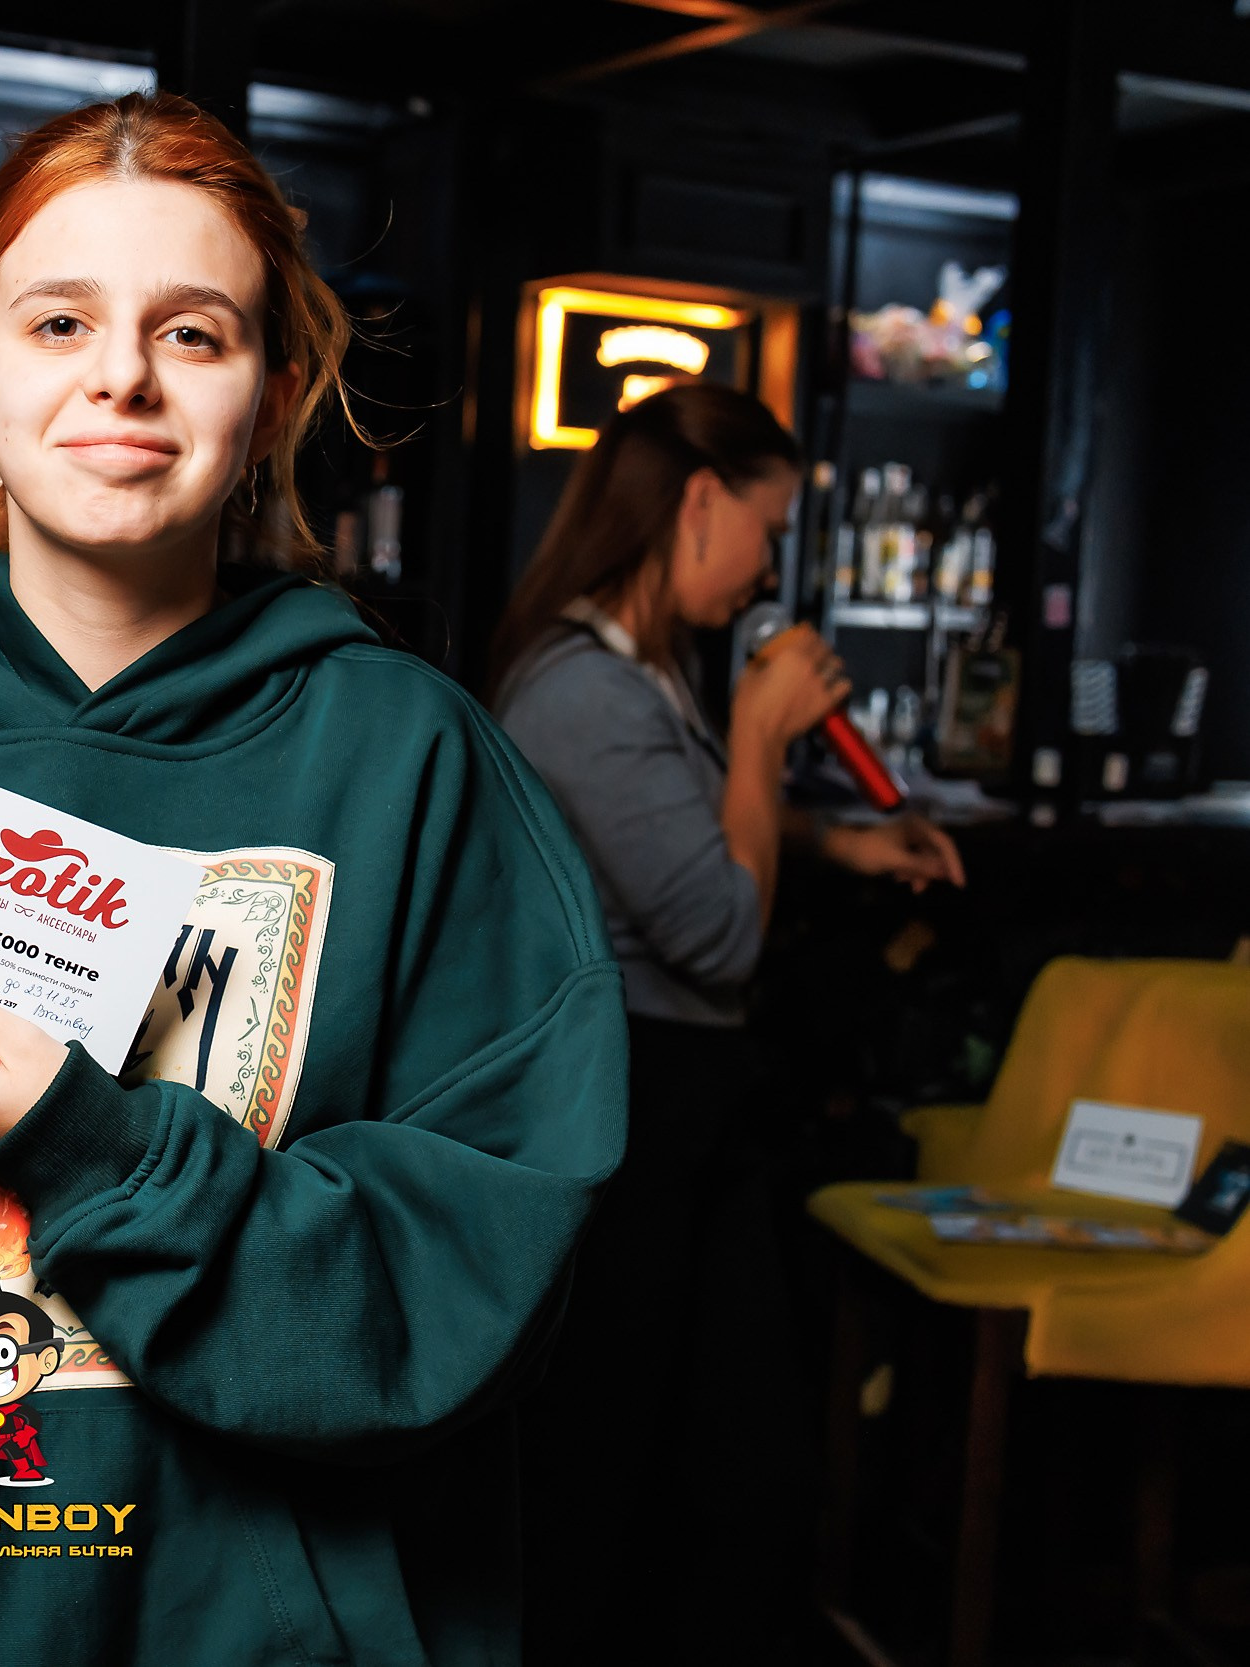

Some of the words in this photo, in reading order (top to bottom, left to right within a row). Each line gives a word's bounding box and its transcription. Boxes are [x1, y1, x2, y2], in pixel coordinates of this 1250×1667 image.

[36, 913, 98, 943] АКСЕССУАРЫ
[0, 958, 17, 970] 50%
[17, 966, 59, 986] стоимости
[59, 981, 94, 999] покупки
[44, 952, 100, 982] тенге
[3, 999, 18, 1009] 237
